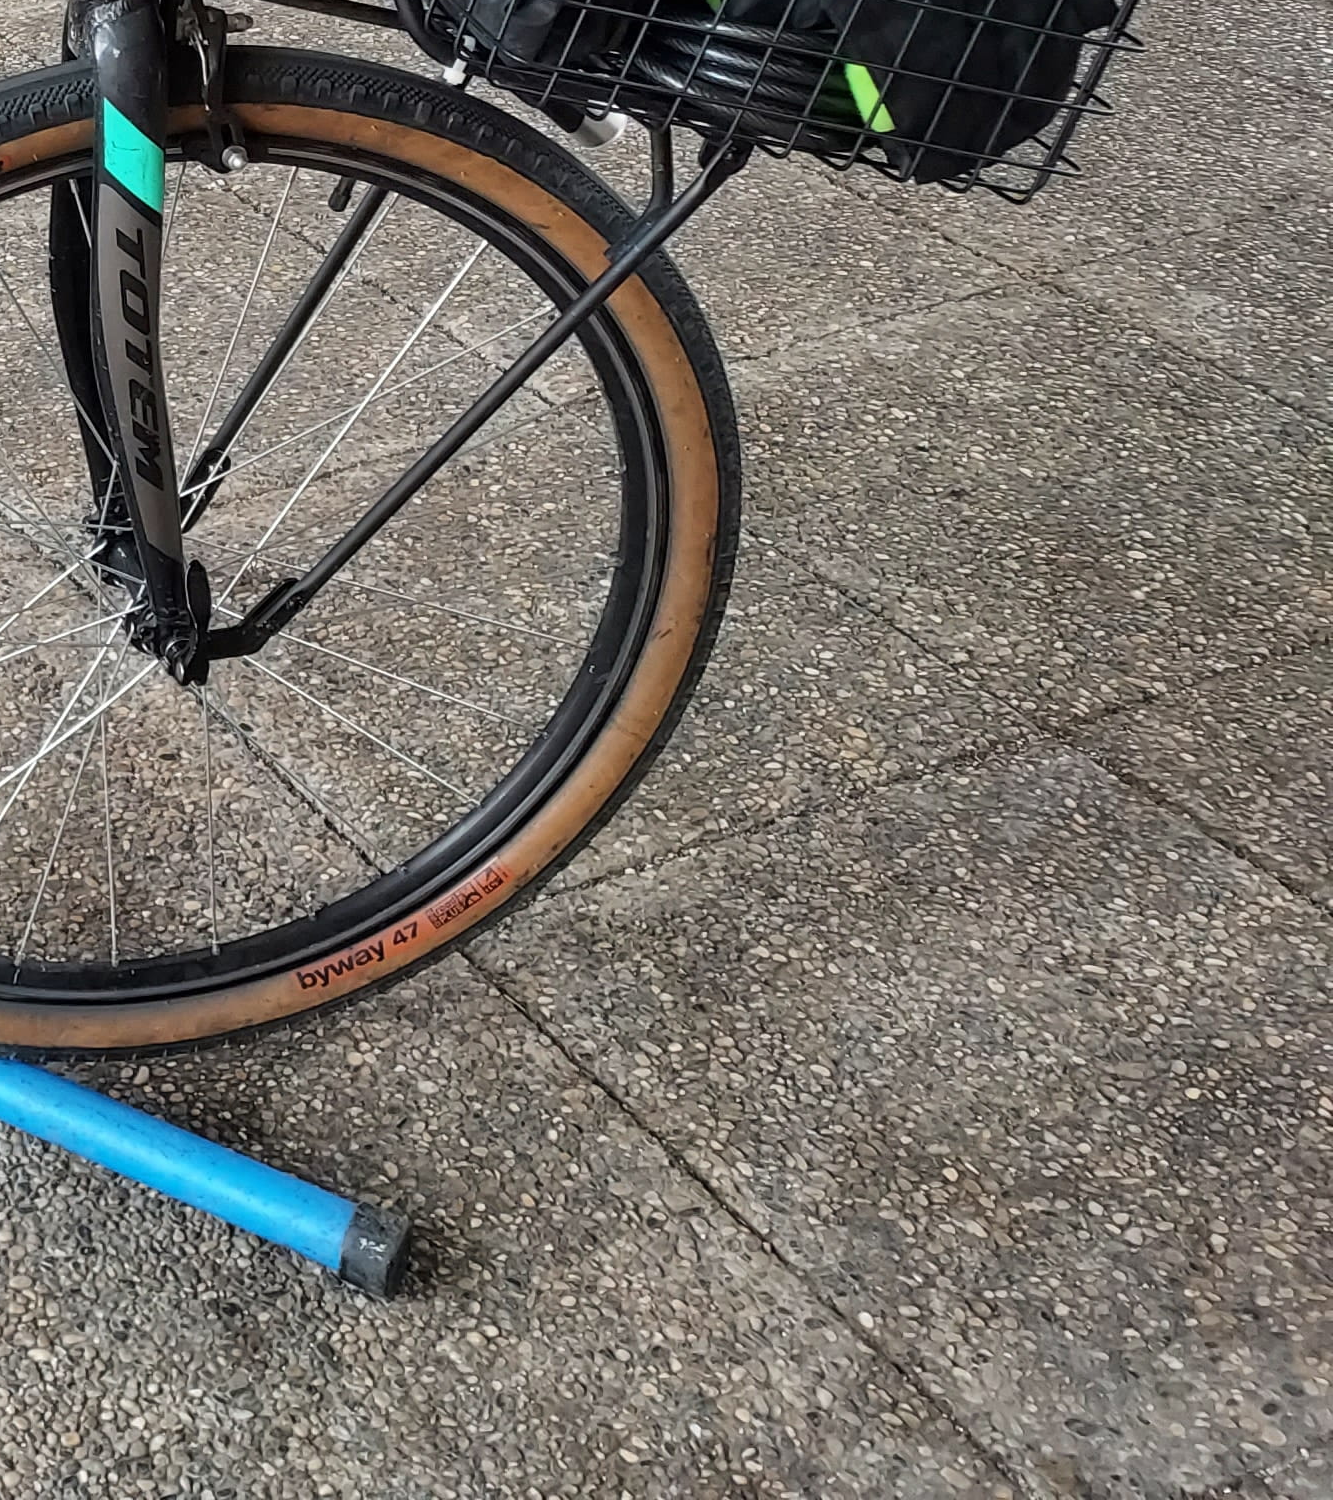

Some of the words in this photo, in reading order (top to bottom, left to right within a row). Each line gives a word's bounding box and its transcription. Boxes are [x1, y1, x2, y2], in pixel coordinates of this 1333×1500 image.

[115, 226, 165, 492] TOTEM
[296, 940, 385, 991] byway
[391, 920, 419, 946] 47
